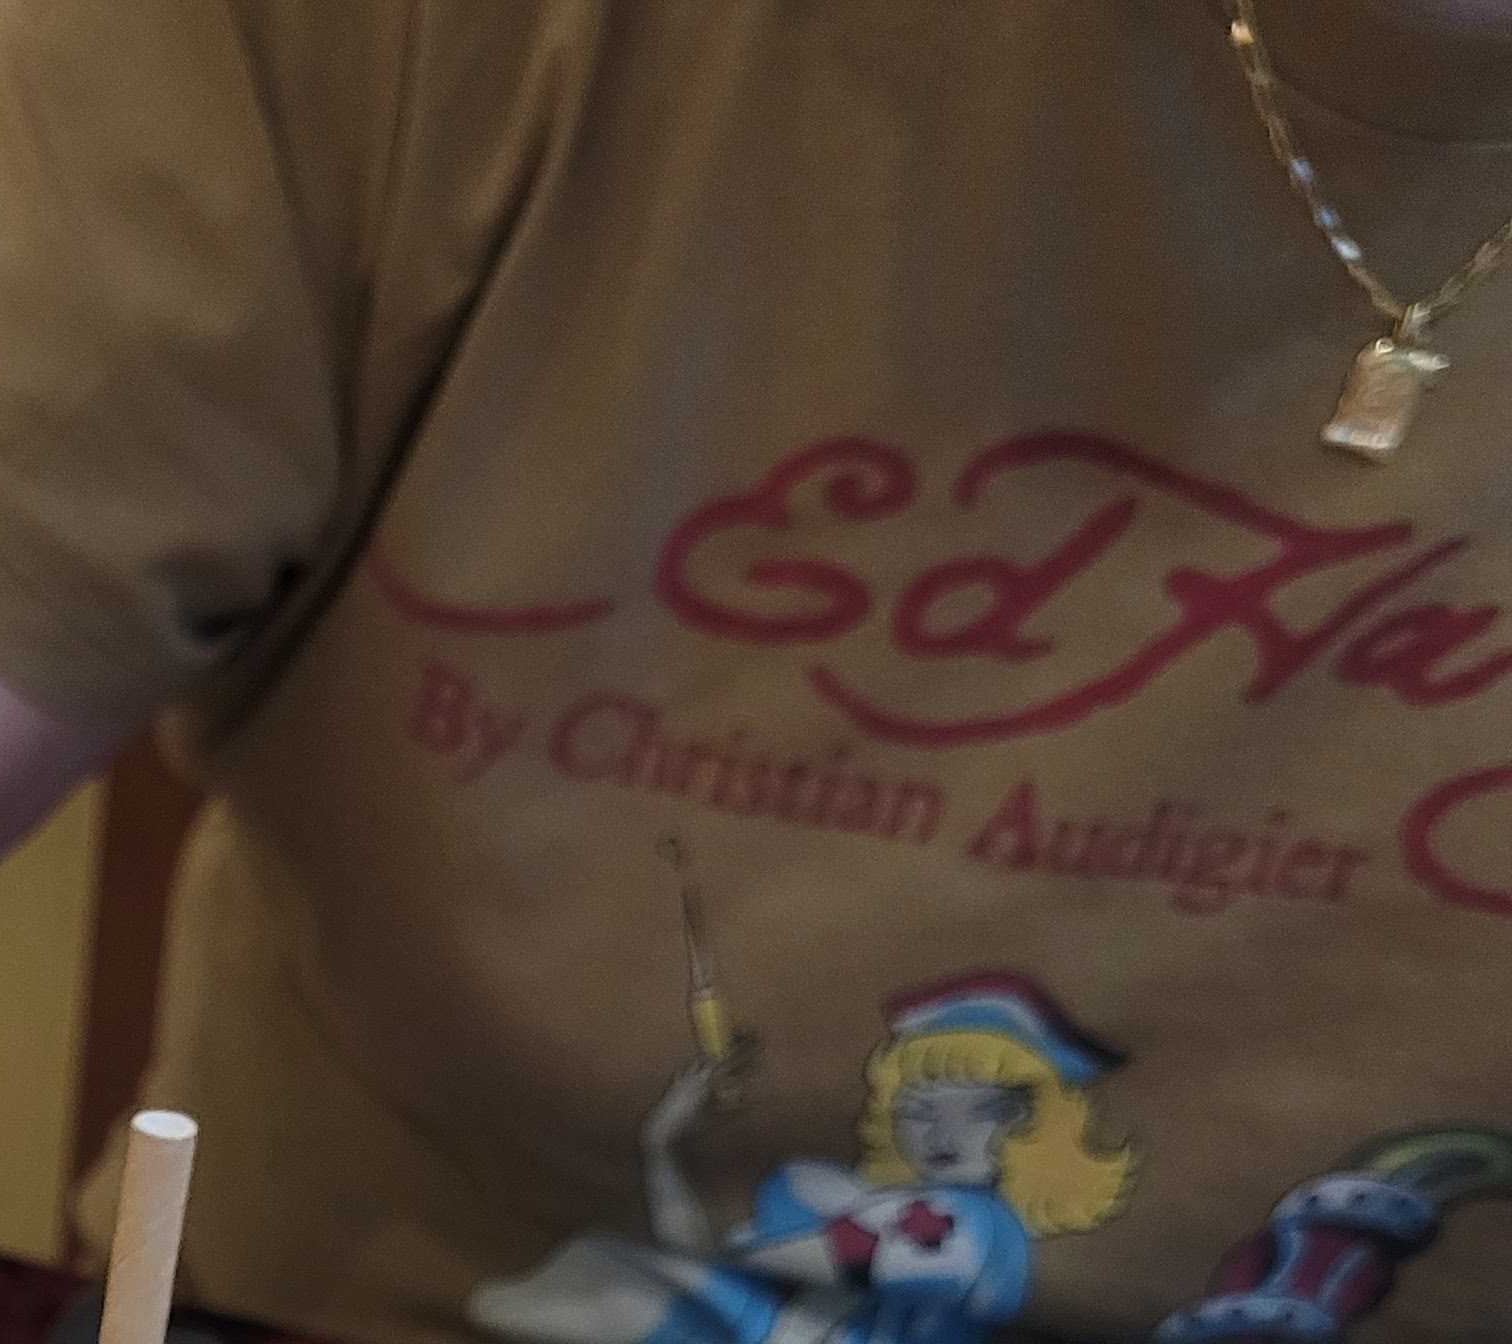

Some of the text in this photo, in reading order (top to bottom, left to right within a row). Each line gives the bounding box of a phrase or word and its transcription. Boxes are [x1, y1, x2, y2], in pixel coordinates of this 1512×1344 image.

[655, 430, 1512, 745] Ed Ha
[410, 660, 1370, 918] By Christian Audigier
